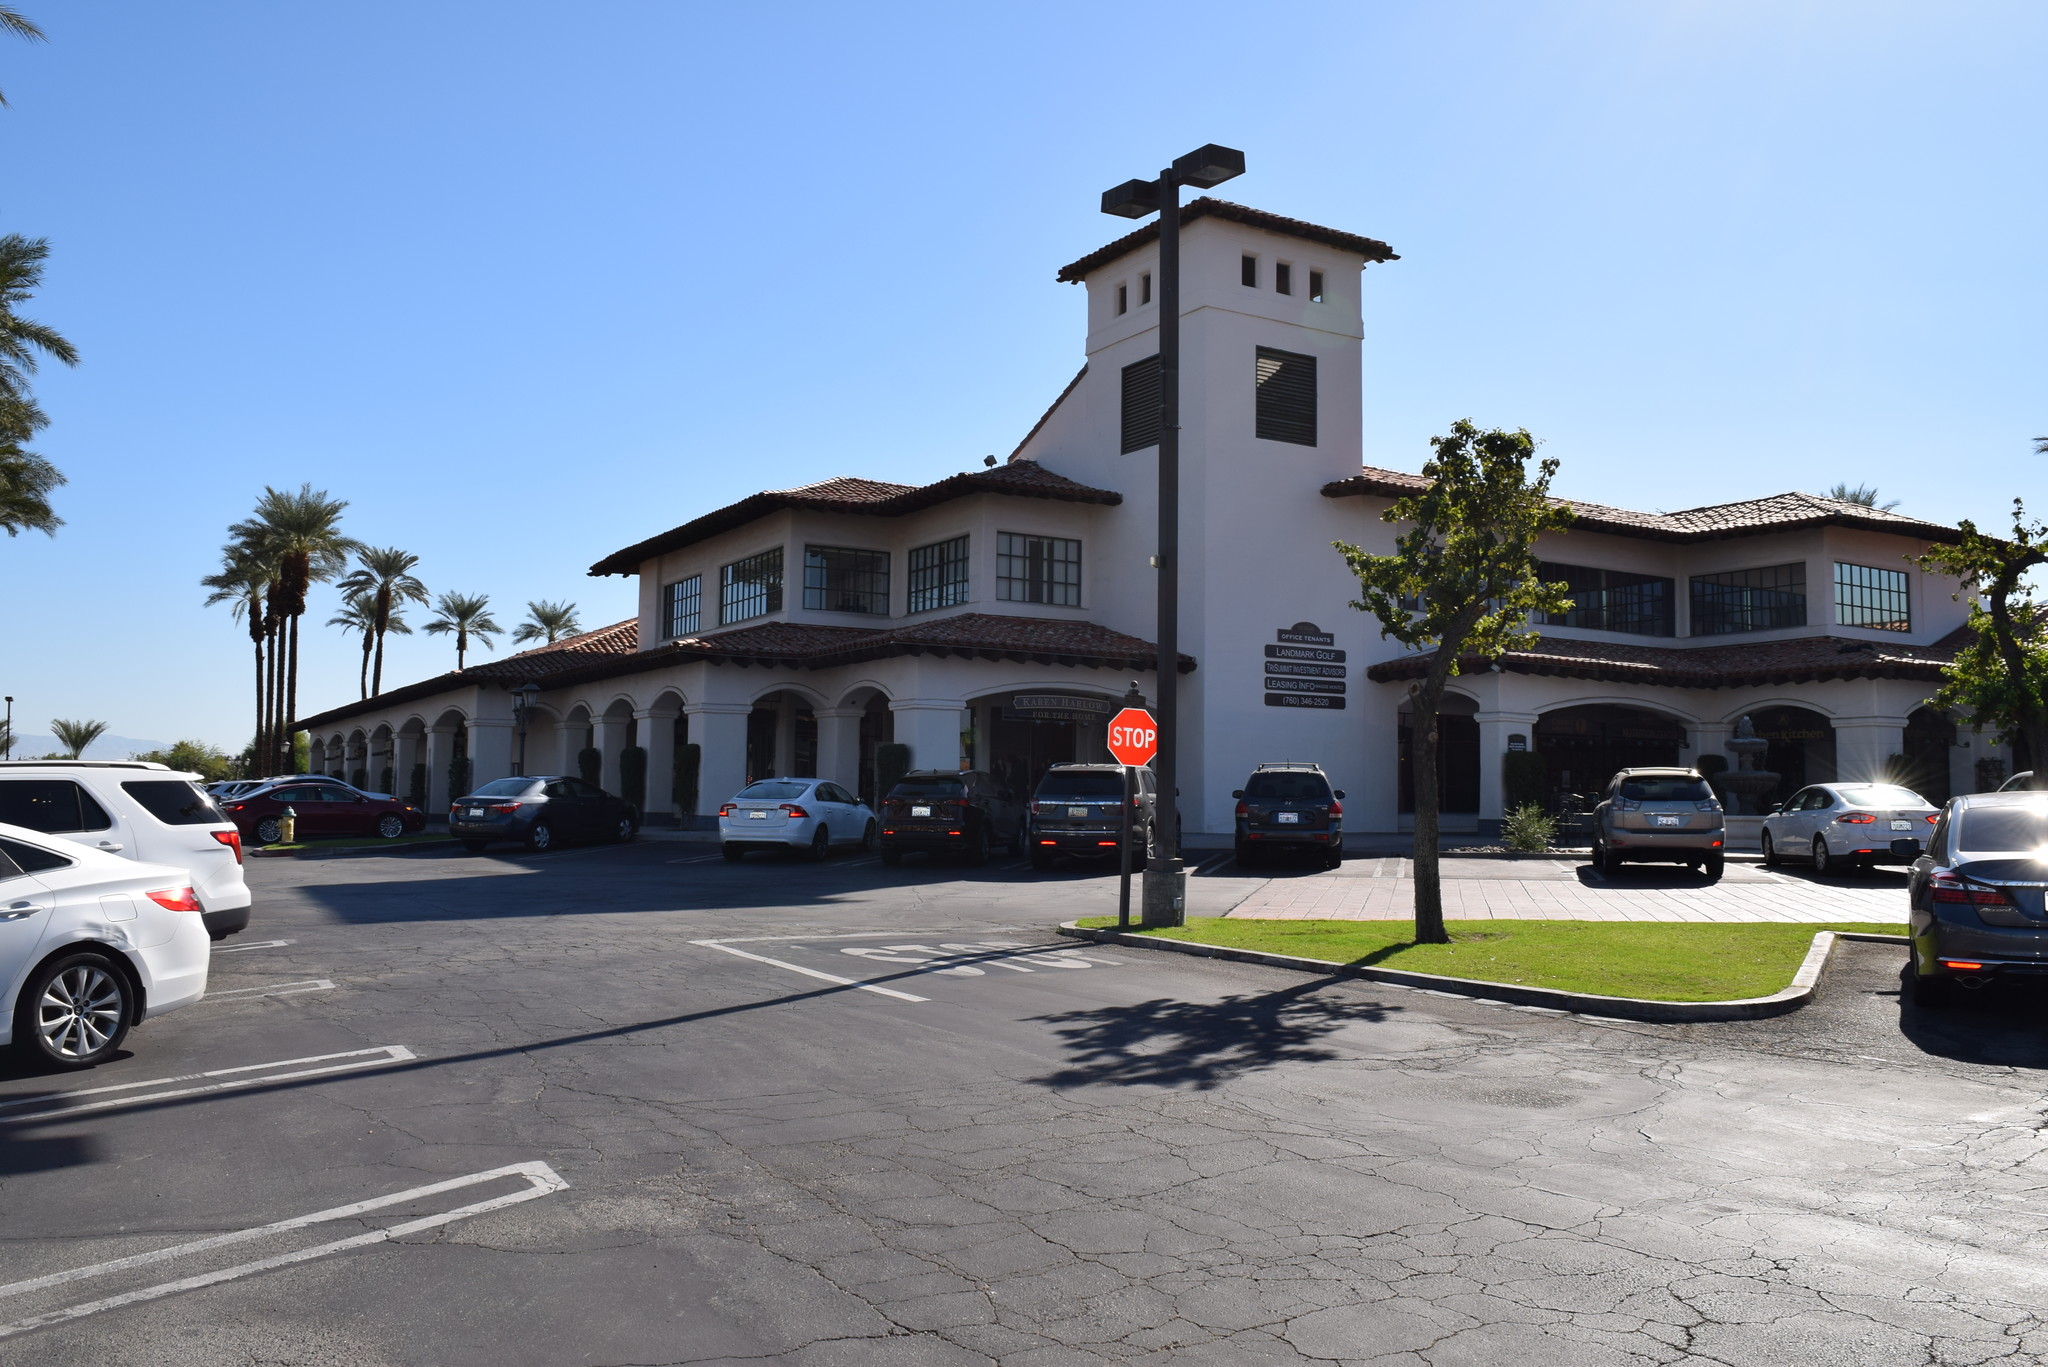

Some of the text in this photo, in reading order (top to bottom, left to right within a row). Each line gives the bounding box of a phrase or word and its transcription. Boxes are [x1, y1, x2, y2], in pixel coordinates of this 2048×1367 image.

[1281, 633, 1331, 643] OFFICE TENANTS
[1276, 647, 1336, 660] LANDMARK GOLF
[1322, 667, 1345, 676] ADVISORS
[1267, 679, 1297, 689] LEASING
[1299, 681, 1315, 690] INFO
[1023, 697, 1104, 710] KAREN HARLOW
[1283, 696, 1329, 706] (760) 346-2520
[1032, 711, 1097, 721] FOR THE HOME
[1112, 726, 1156, 749] STOP
